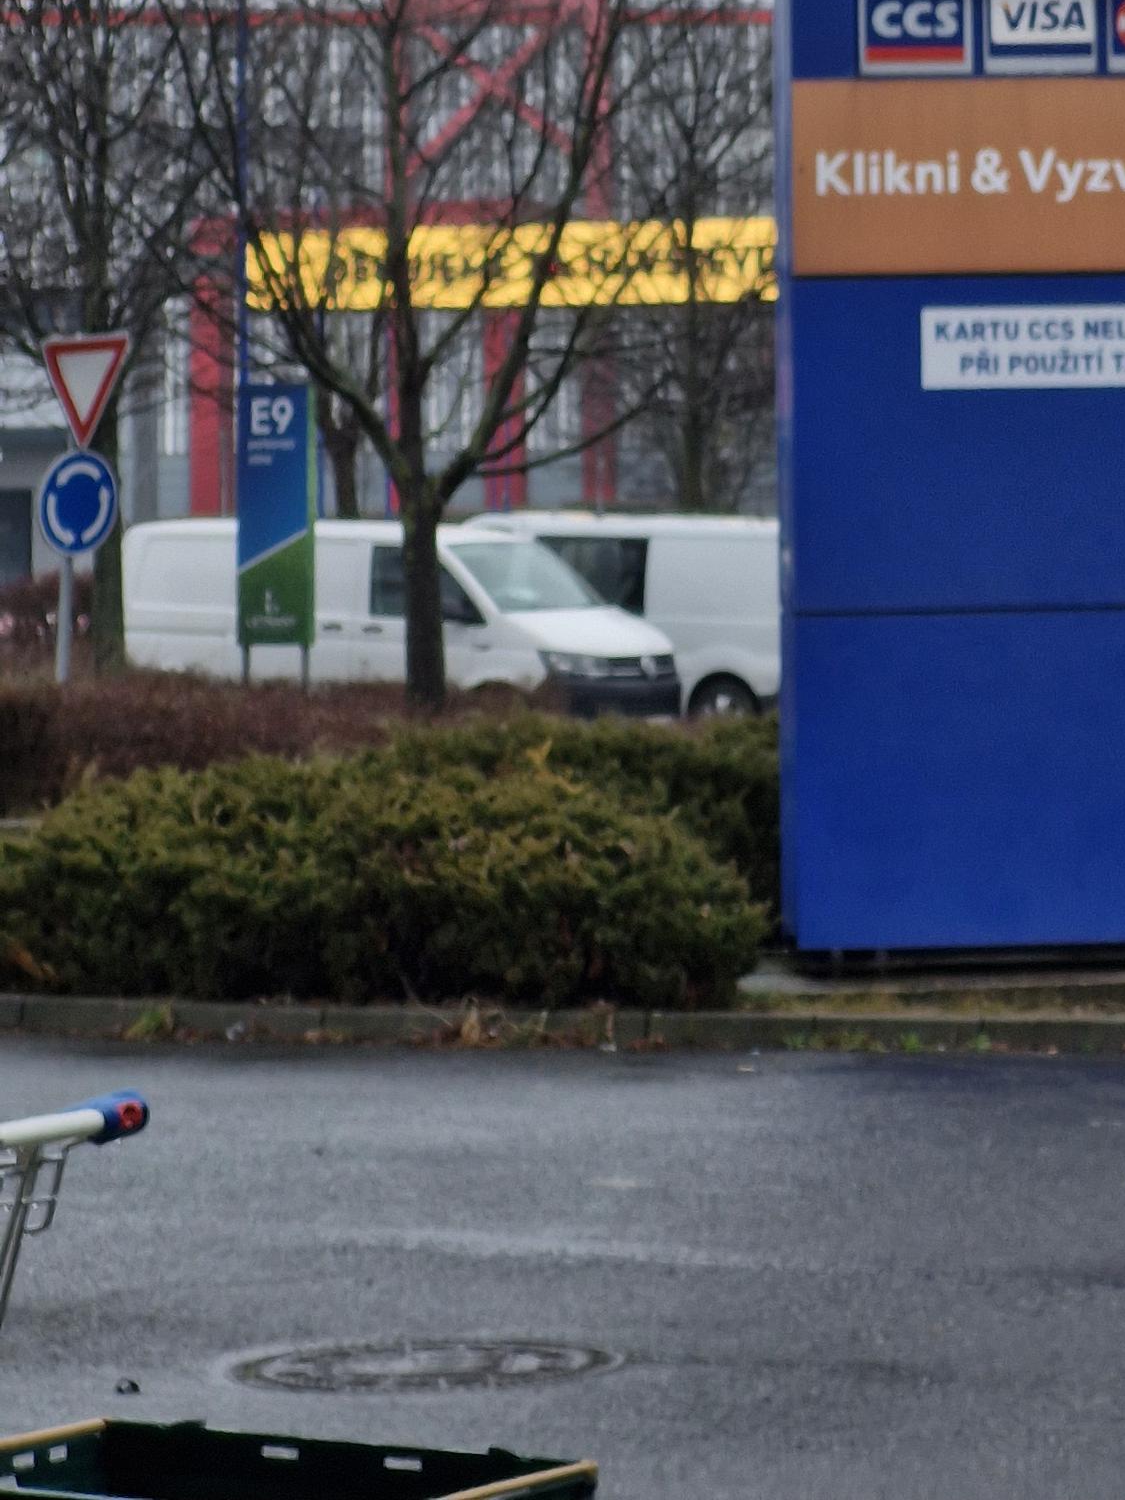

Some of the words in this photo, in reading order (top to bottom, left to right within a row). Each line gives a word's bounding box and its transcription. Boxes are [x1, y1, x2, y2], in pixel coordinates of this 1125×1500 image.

[871, 0, 959, 38] CCS
[1001, 0, 1087, 32] VISA
[815, 150, 960, 196] Klikni
[971, 148, 1009, 194] &
[935, 318, 1019, 342] KARTU
[1028, 318, 1075, 341] CCS
[960, 348, 999, 376] PŘI
[1008, 347, 1104, 375] POUŽITÍ
[250, 395, 294, 435] E9
